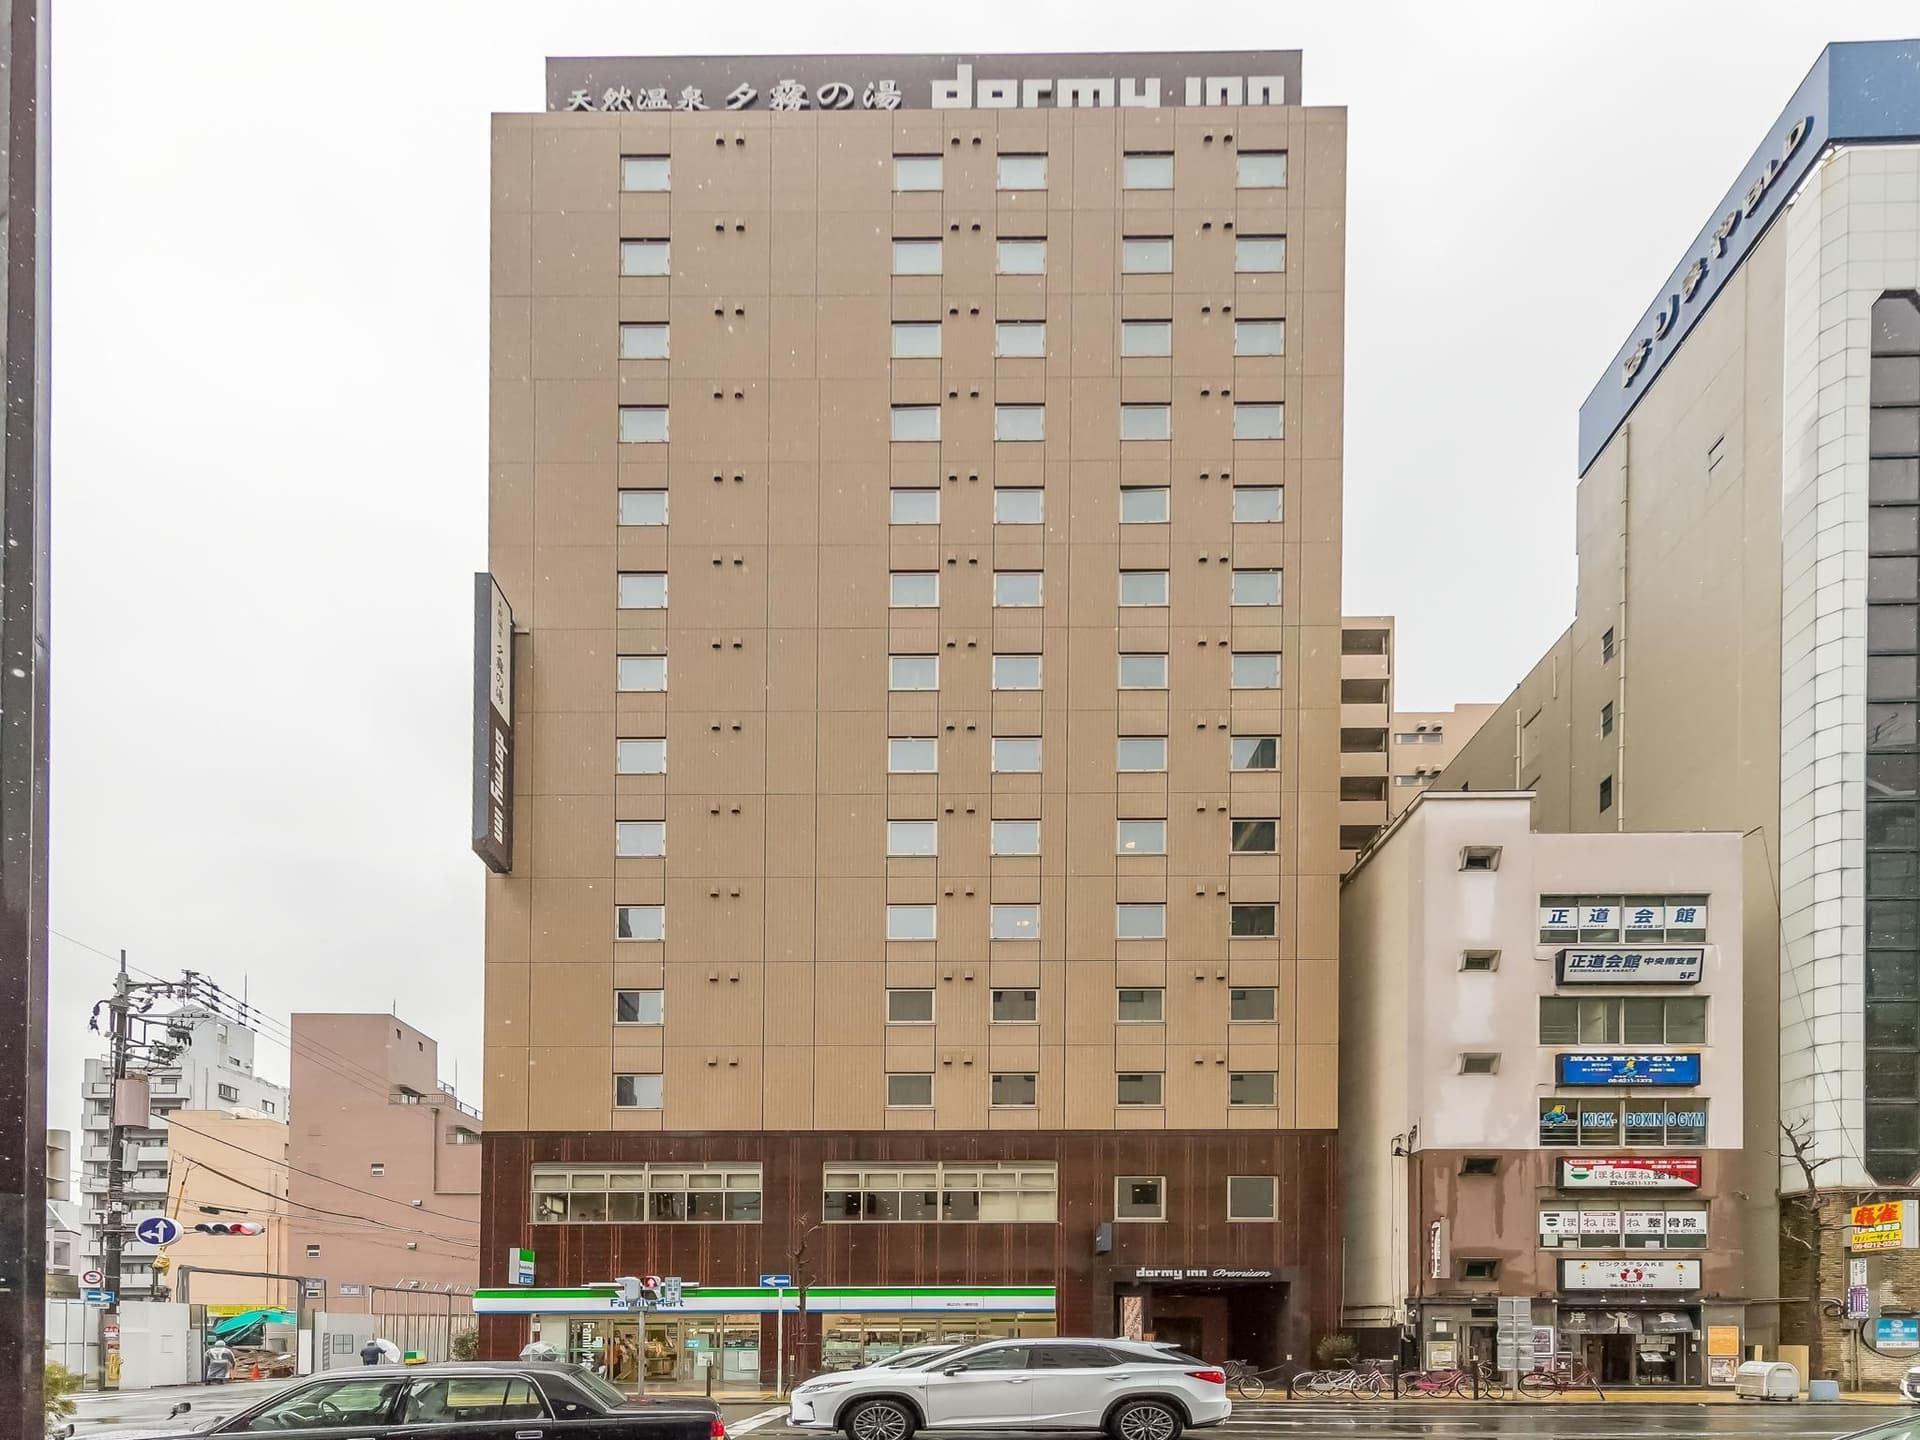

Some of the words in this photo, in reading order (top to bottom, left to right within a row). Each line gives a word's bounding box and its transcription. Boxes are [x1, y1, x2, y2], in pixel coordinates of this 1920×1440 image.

[931, 63, 1161, 108] dormy
[1185, 75, 1285, 107] inn
[567, 85, 710, 112] 天然温泉
[726, 79, 902, 112] 夕霧の湯
[490, 727, 508, 807] dormy
[494, 806, 504, 845] inn
[1569, 955, 1642, 968] 正道会館
[1644, 957, 1697, 965] 中央南支部
[1680, 971, 1696, 979] 5F
[1582, 1112, 1617, 1127] KICK-
[1677, 1112, 1705, 1127] GYM
[1854, 1204, 1899, 1225] 麻雀
[1562, 1217, 1697, 1228] ほねほね整骨院
[1136, 1267, 1183, 1280] dormy
[1212, 1268, 1272, 1277] Premium
[610, 1298, 684, 1308] Failart
